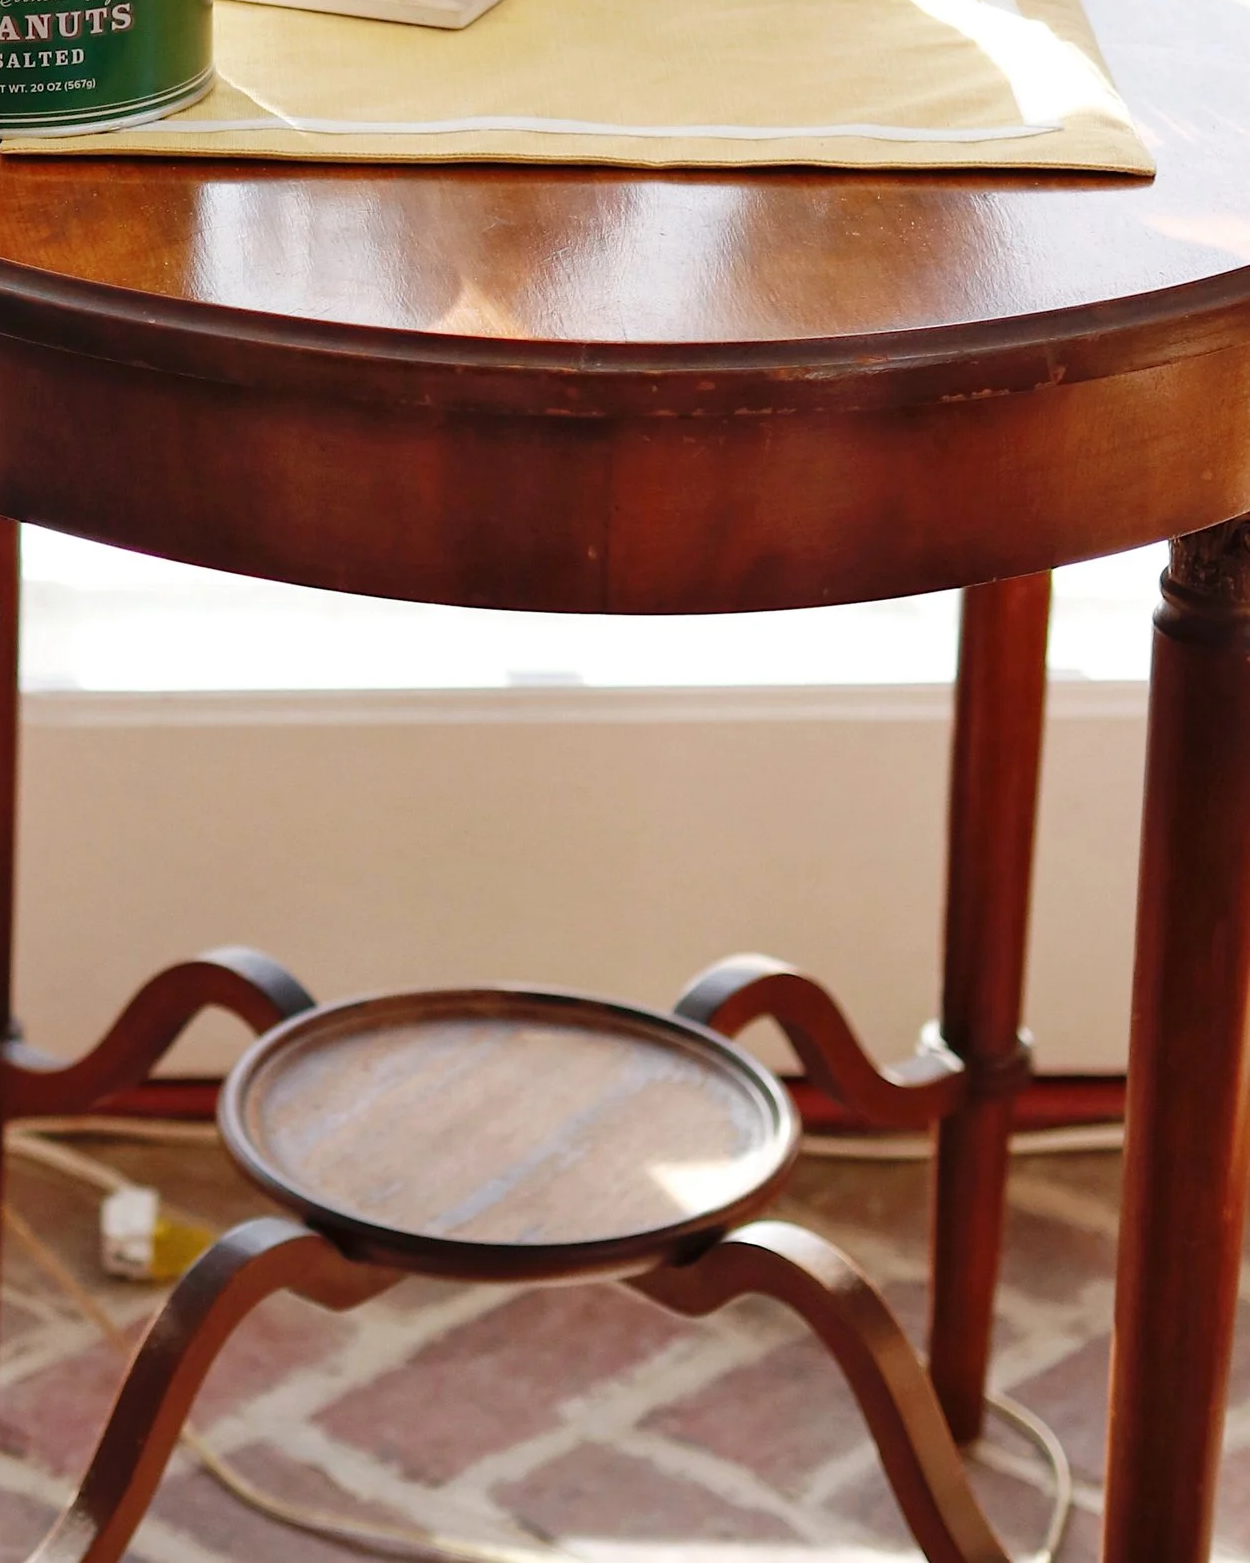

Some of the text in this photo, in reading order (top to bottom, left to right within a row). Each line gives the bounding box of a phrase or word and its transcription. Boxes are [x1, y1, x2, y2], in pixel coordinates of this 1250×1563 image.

[7, 84, 28, 94] WT.
[30, 83, 45, 93] 20
[46, 82, 63, 92] OZ
[64, 78, 97, 92] (567g)
